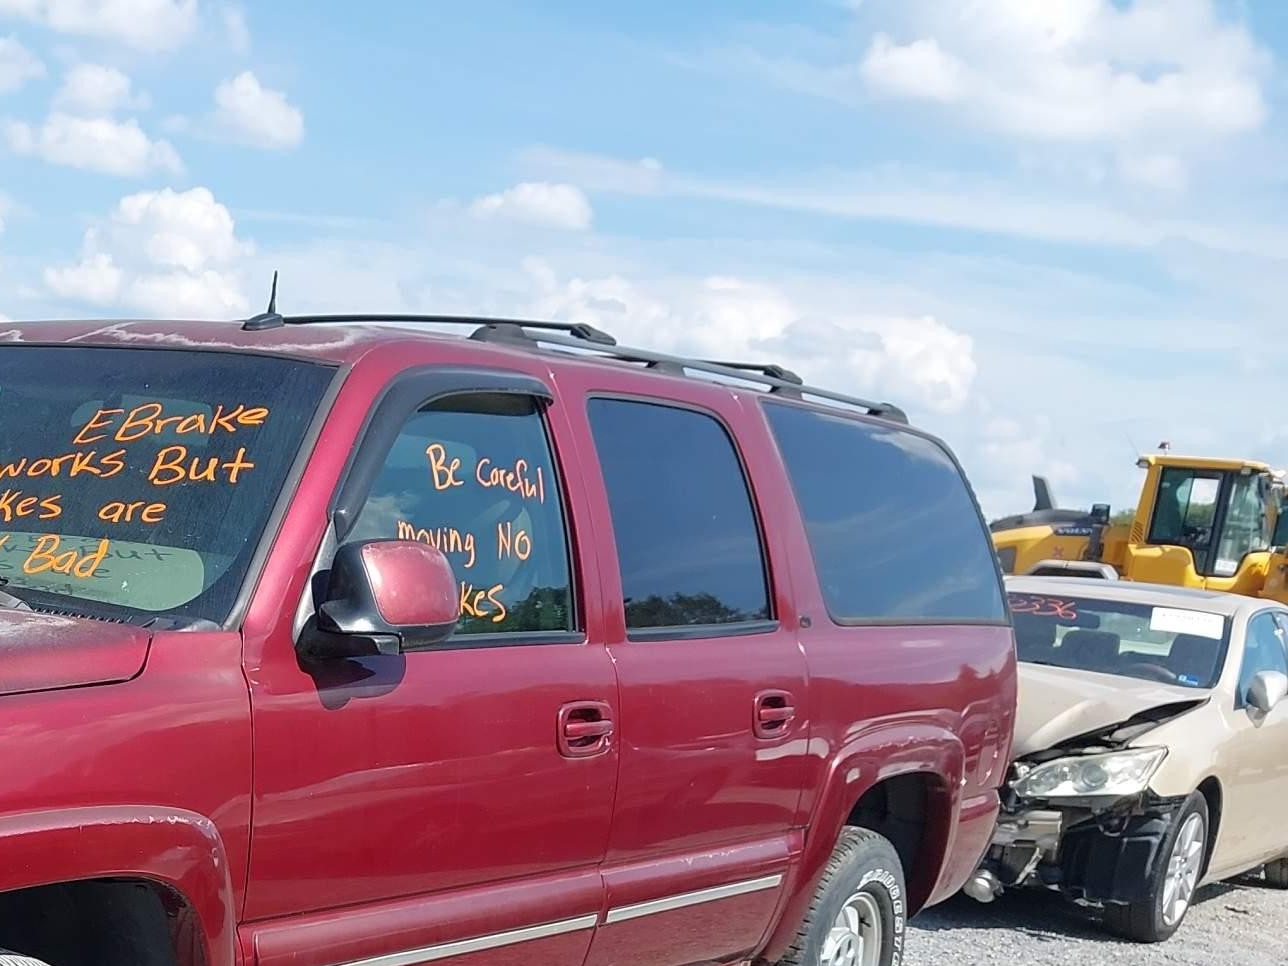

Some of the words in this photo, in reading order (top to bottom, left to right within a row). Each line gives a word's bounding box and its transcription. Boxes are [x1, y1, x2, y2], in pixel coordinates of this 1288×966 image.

[147, 445, 254, 486] But
[425, 443, 464, 490] Be
[476, 458, 544, 504] Careful
[97, 501, 167, 523] are
[23, 533, 110, 578] Bad
[498, 521, 531, 561] NO
[458, 581, 506, 623] kes
